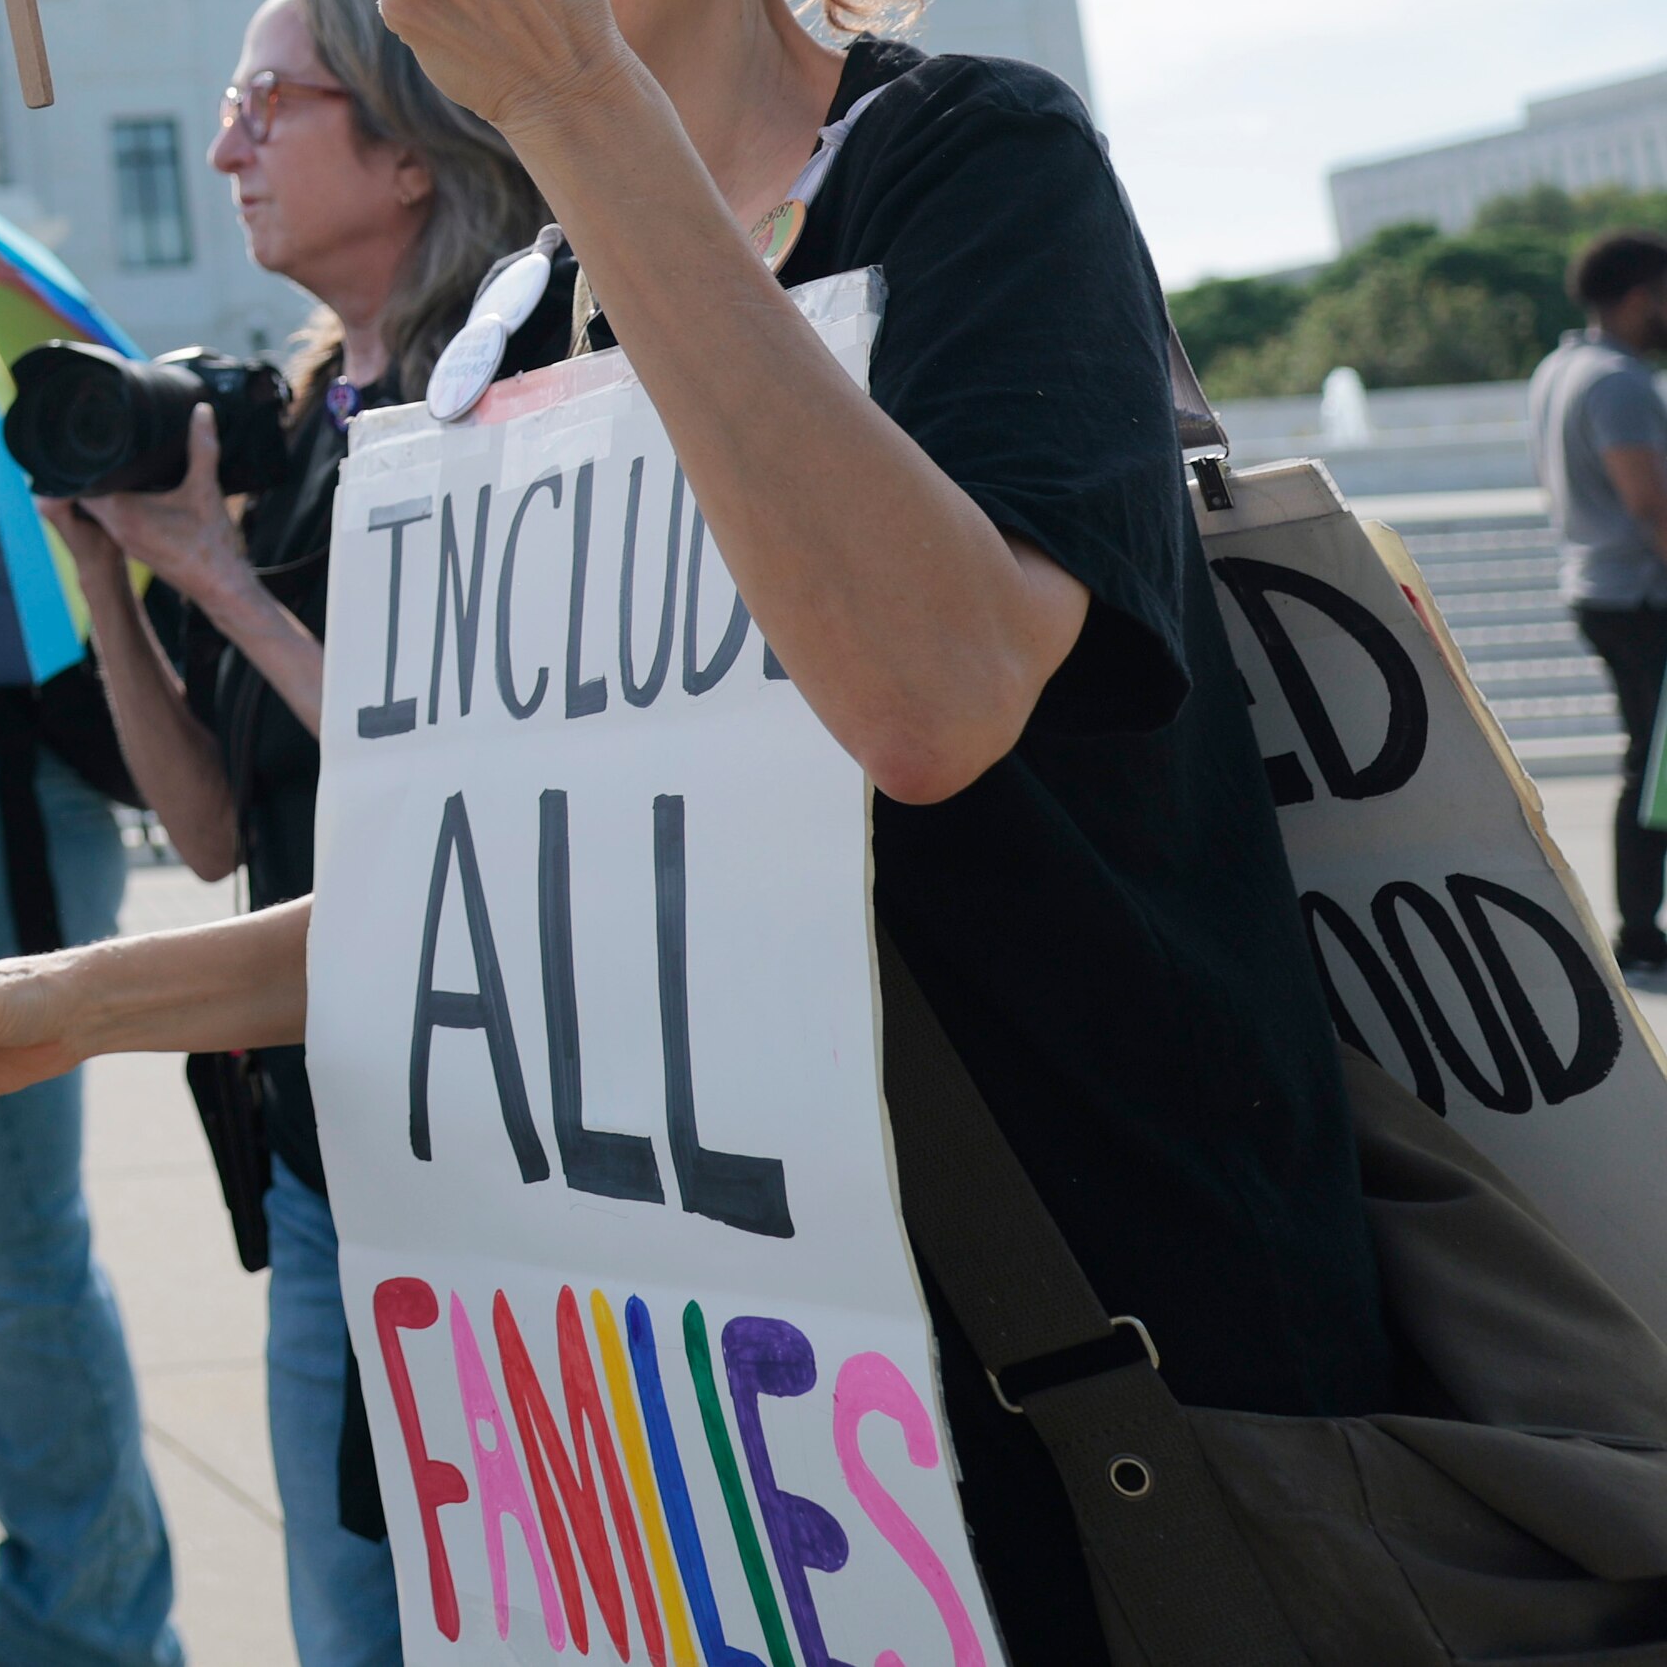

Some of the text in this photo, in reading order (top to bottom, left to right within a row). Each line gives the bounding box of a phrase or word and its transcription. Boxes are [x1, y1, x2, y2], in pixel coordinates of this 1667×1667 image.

[356, 455, 791, 739] INCLUD
[407, 788, 795, 1238] ALL
[372, 1276, 988, 1667] FAMILIES
